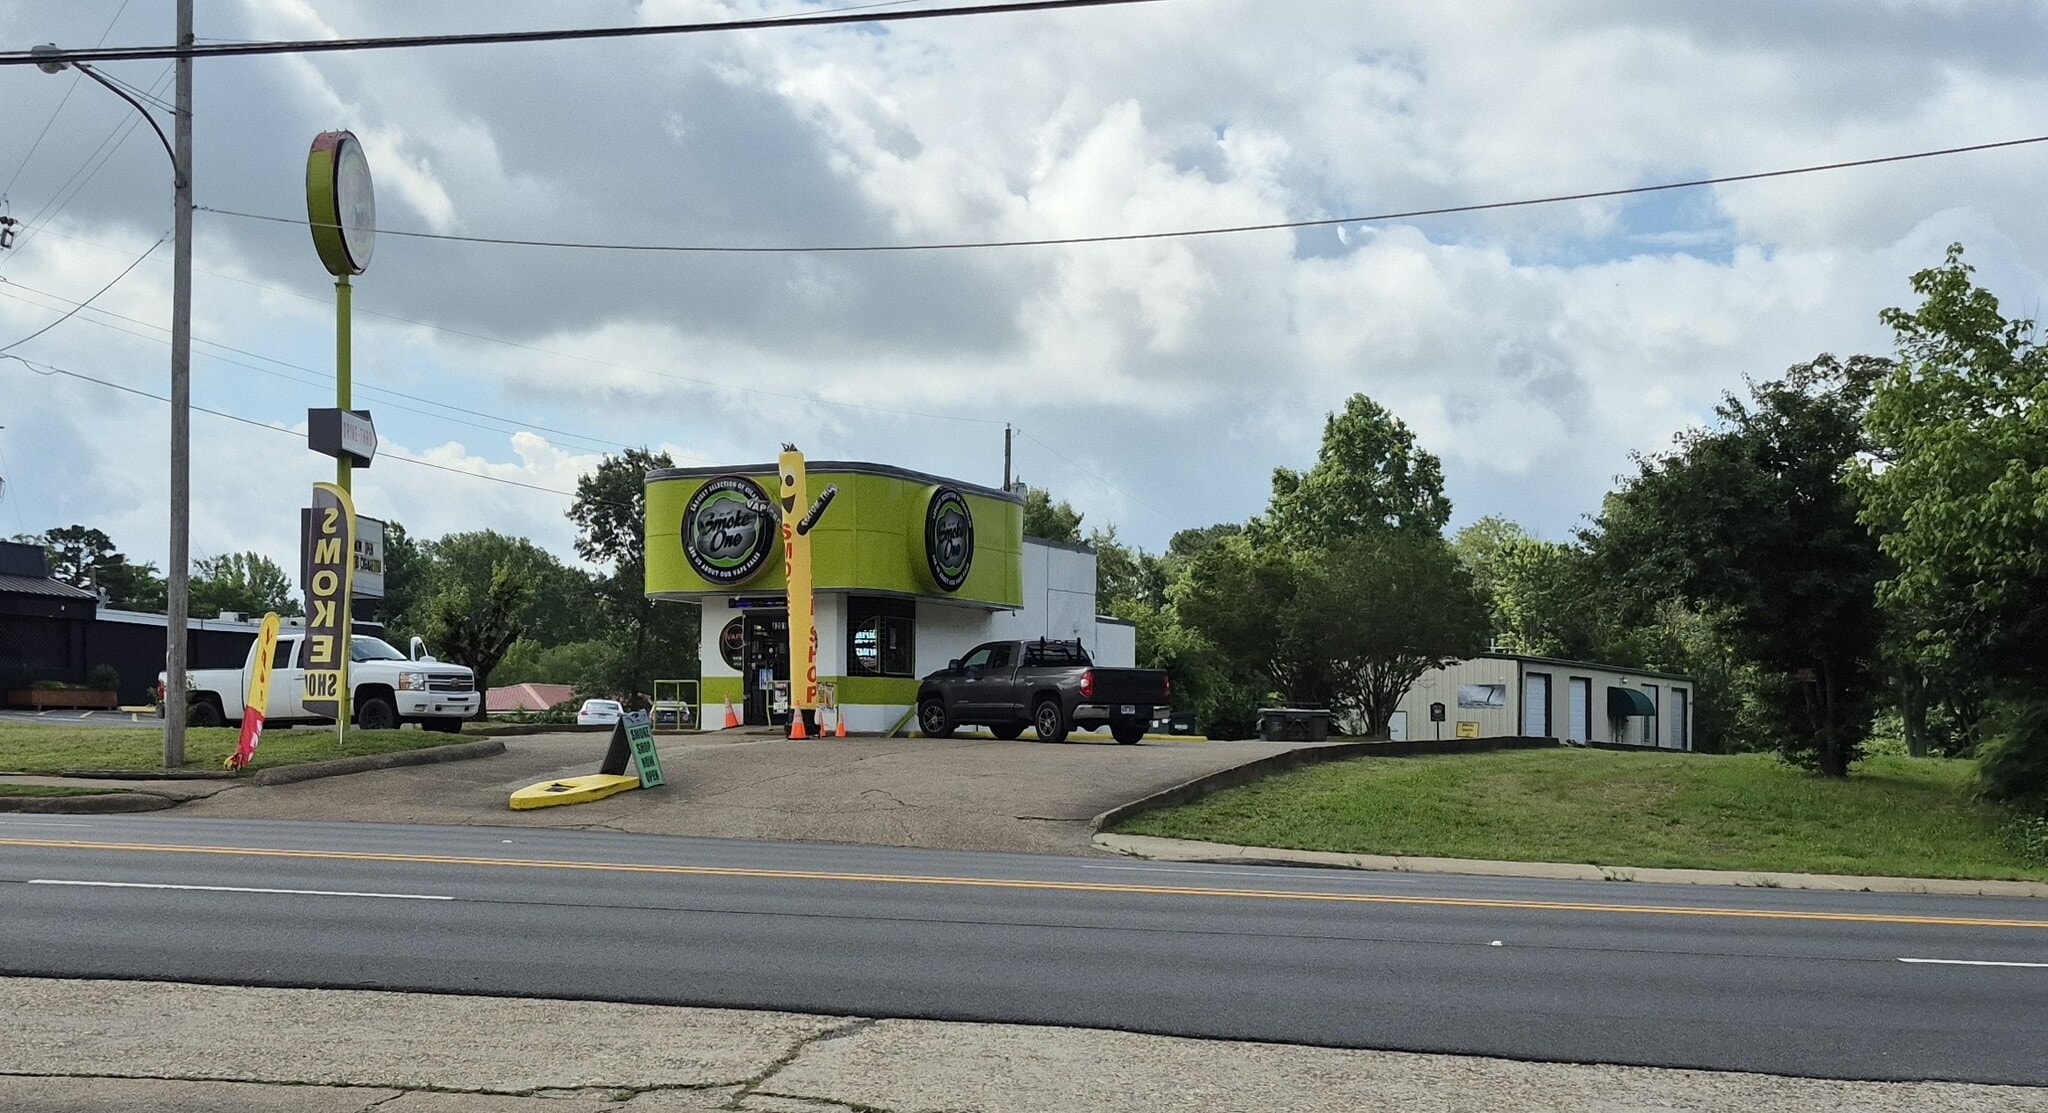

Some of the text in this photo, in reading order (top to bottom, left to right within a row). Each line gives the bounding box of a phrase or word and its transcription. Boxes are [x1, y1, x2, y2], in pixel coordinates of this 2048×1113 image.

[697, 510, 756, 536] Smoke
[710, 529, 743, 553] One
[630, 726, 650, 741] SMOKE
[644, 769, 660, 783] OPEN
